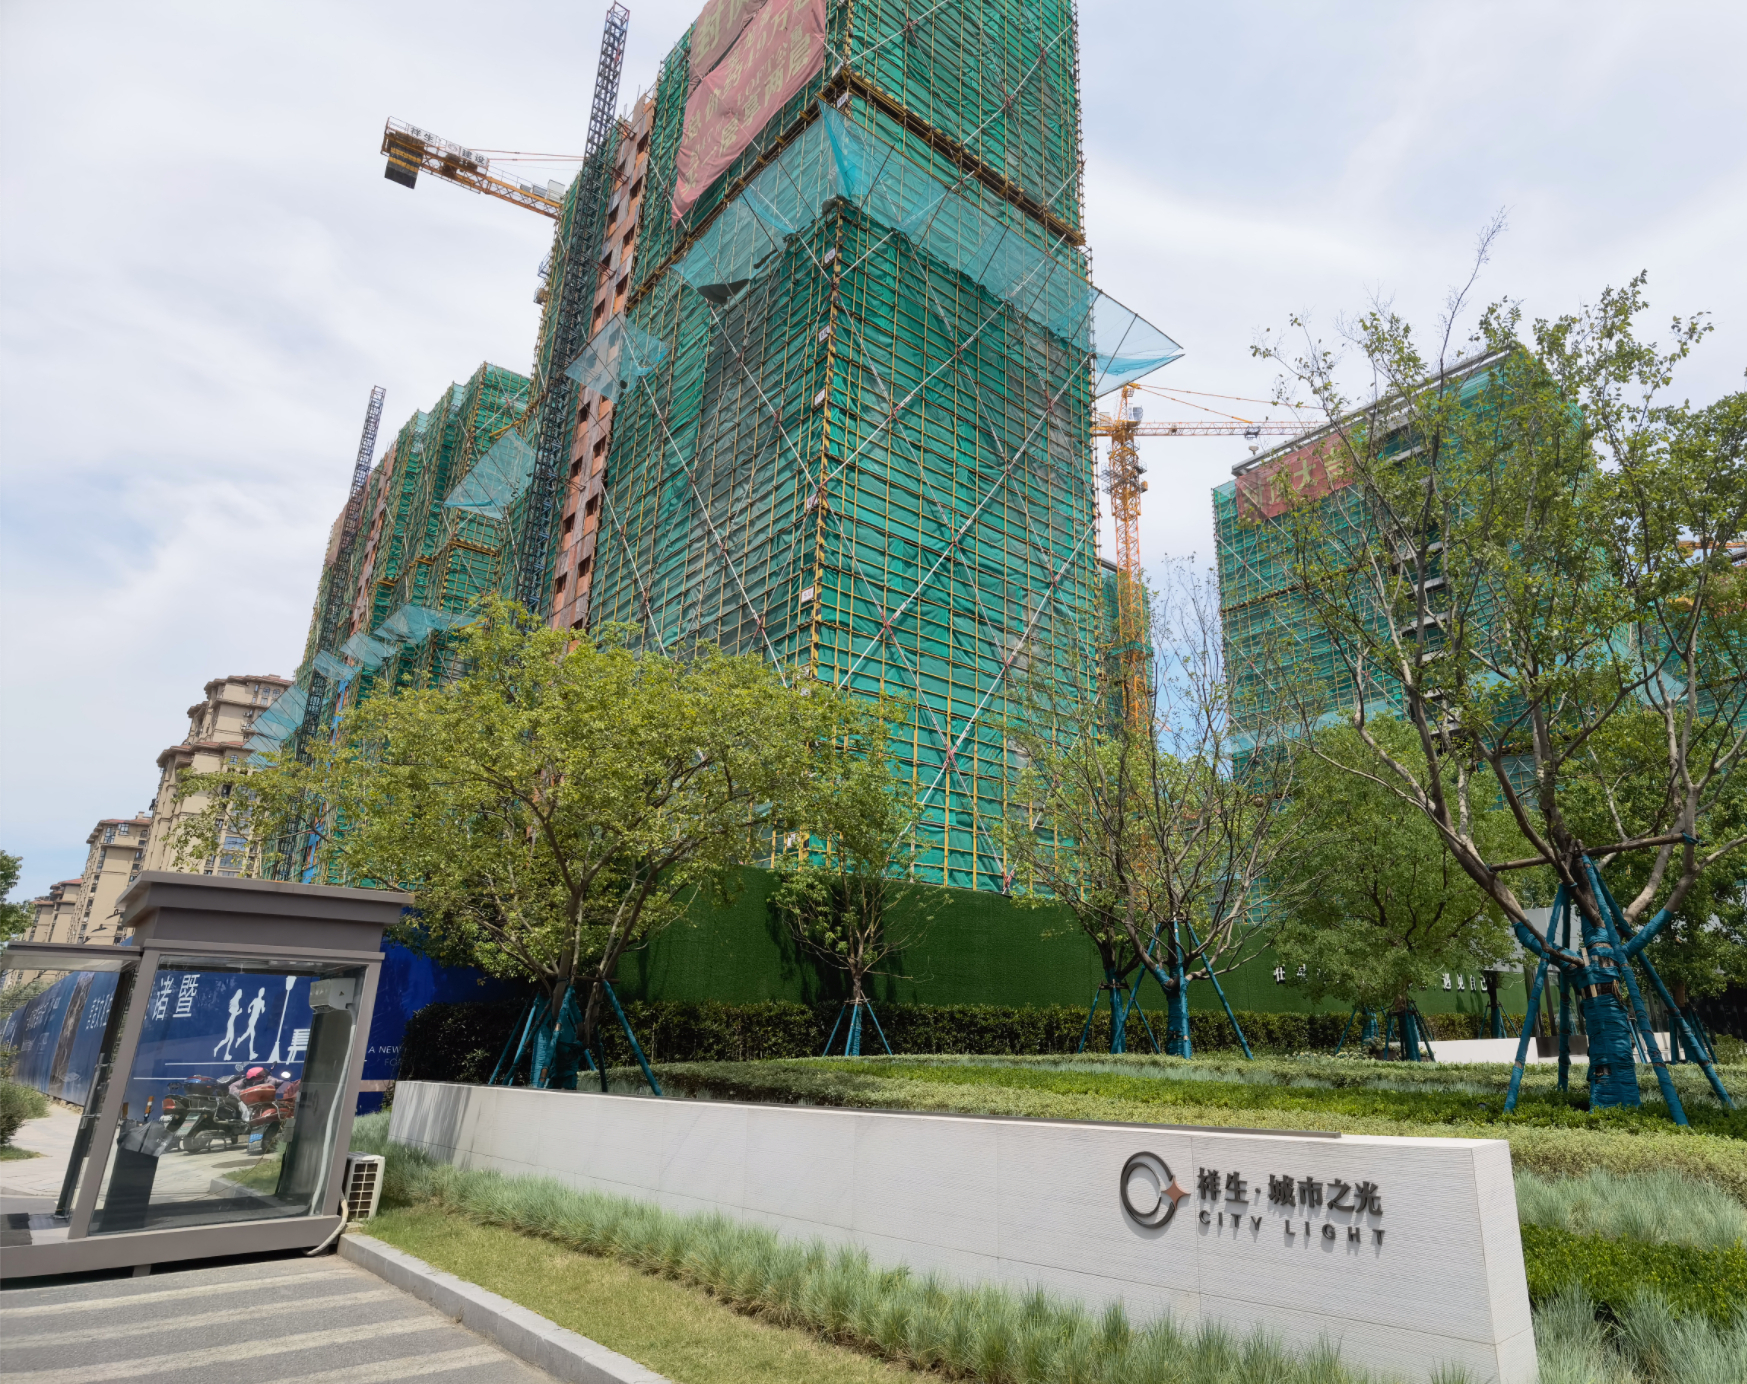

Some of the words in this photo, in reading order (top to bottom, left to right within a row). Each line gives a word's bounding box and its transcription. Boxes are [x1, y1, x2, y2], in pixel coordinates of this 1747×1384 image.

[410, 126, 434, 144] 祥生
[151, 974, 200, 1020] 诸暨
[1198, 1167, 1383, 1216] 祥生·城市之光
[1199, 1210, 1262, 1232] CITY
[1285, 1219, 1385, 1246] LIGHT
